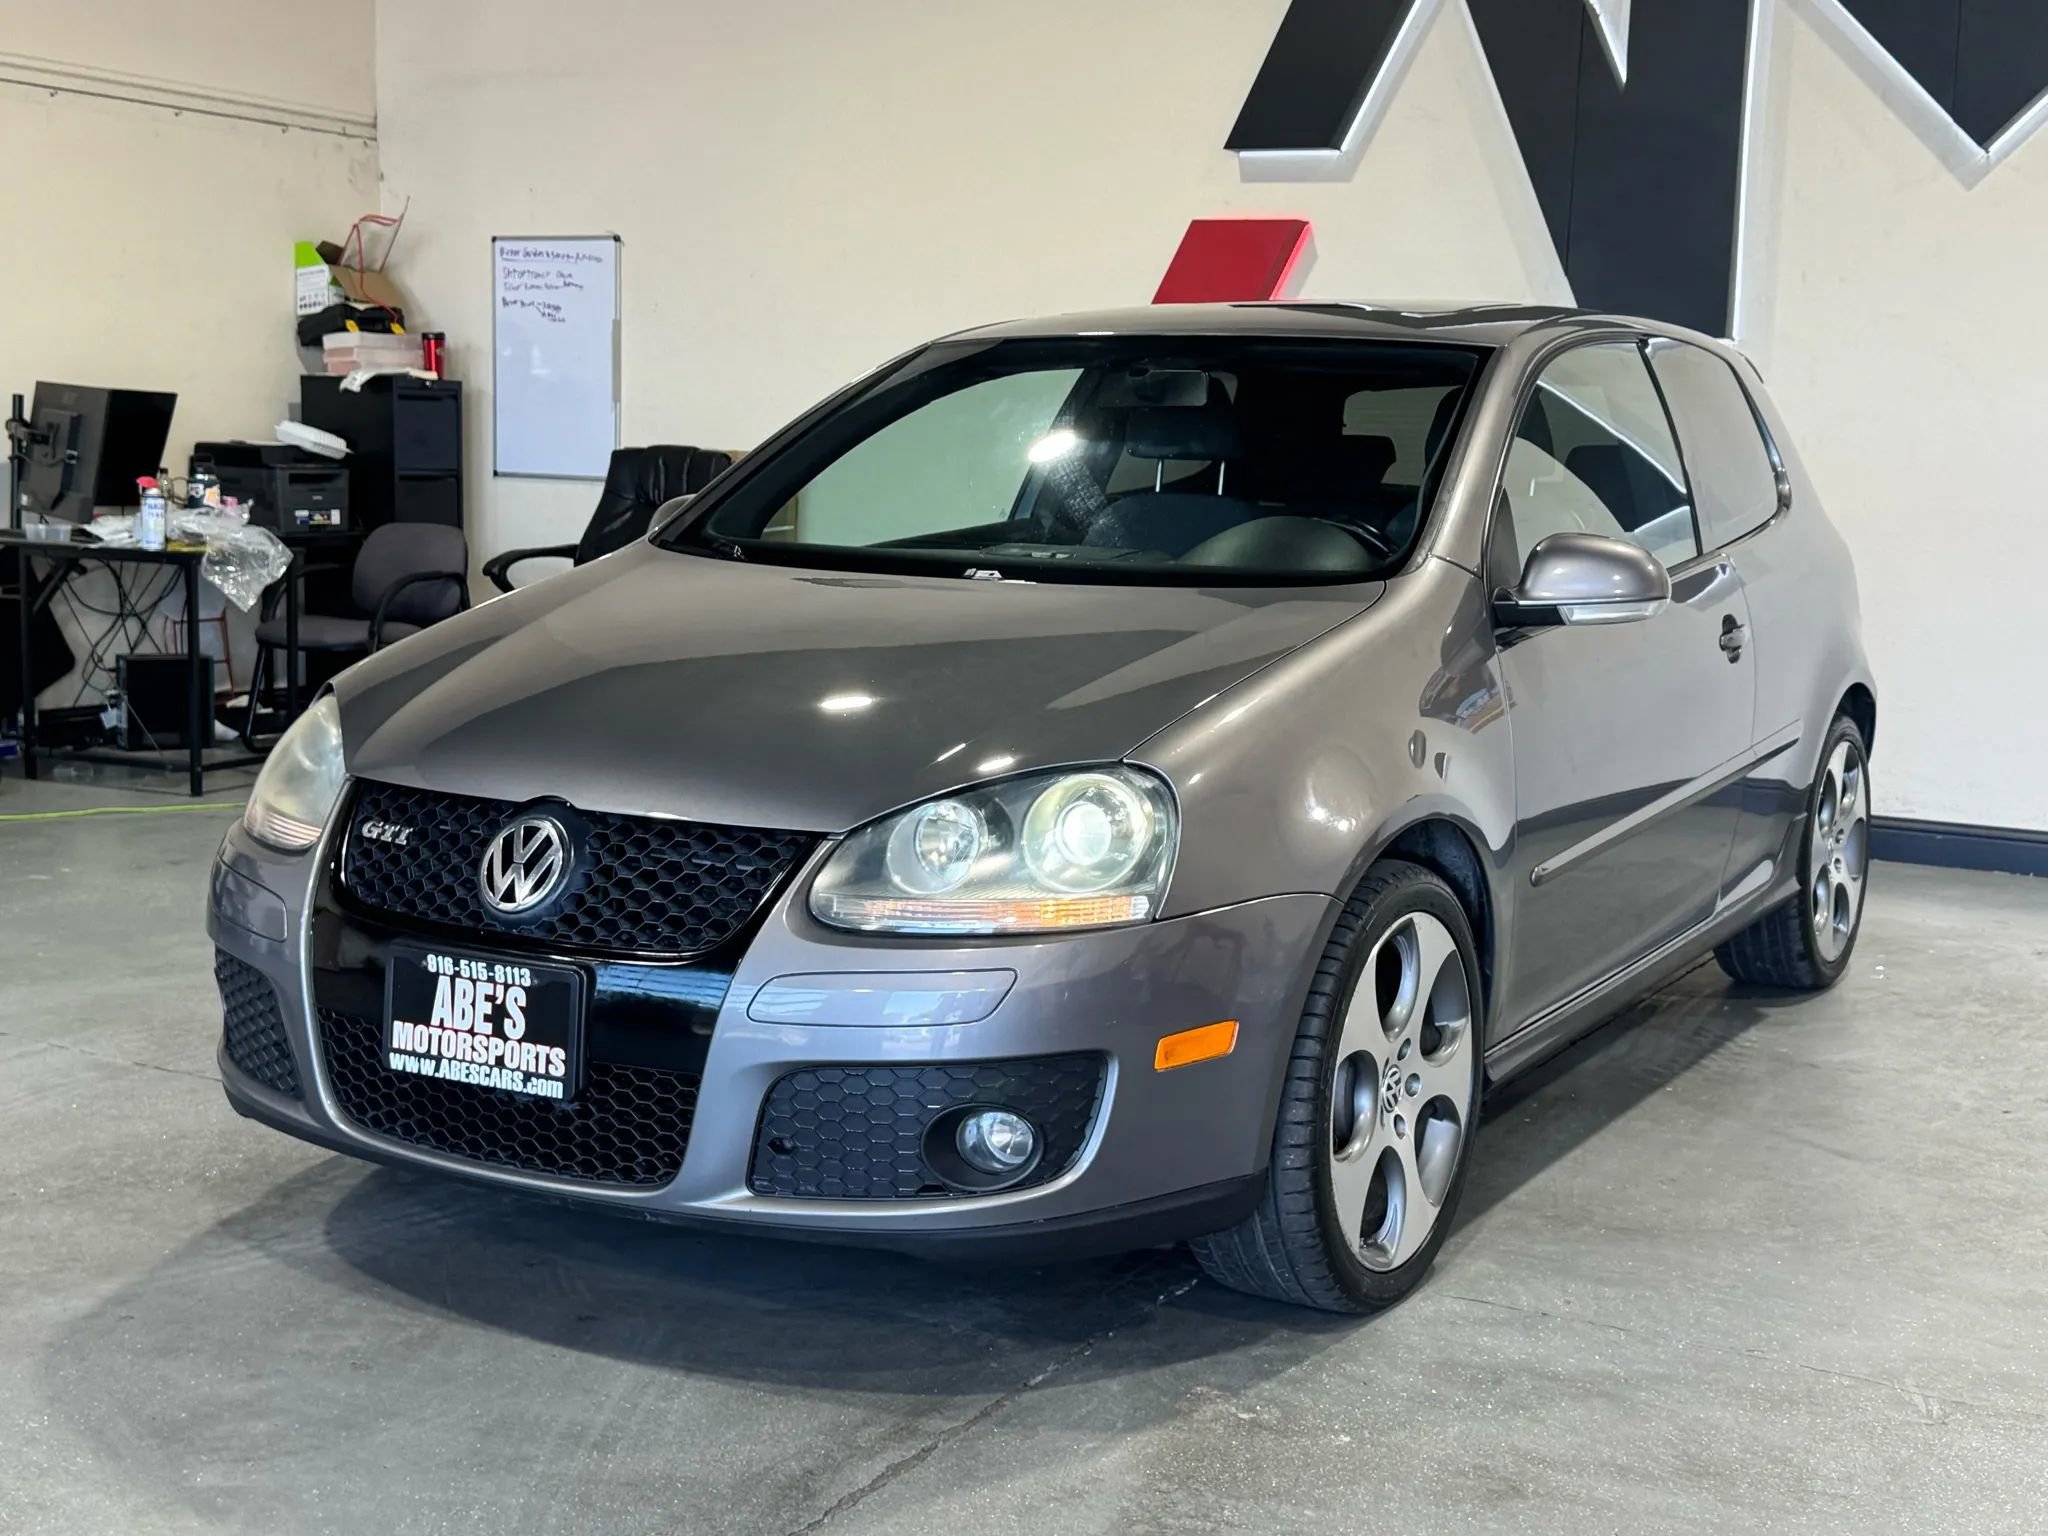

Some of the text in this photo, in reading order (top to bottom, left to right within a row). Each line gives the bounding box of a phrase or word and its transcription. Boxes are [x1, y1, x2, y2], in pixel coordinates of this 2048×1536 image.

[362, 821, 413, 846] GTI
[427, 954, 531, 986] 916-515-8113
[430, 975, 526, 1040] ABE'S
[392, 1020, 566, 1077] MOTORSPORTS
